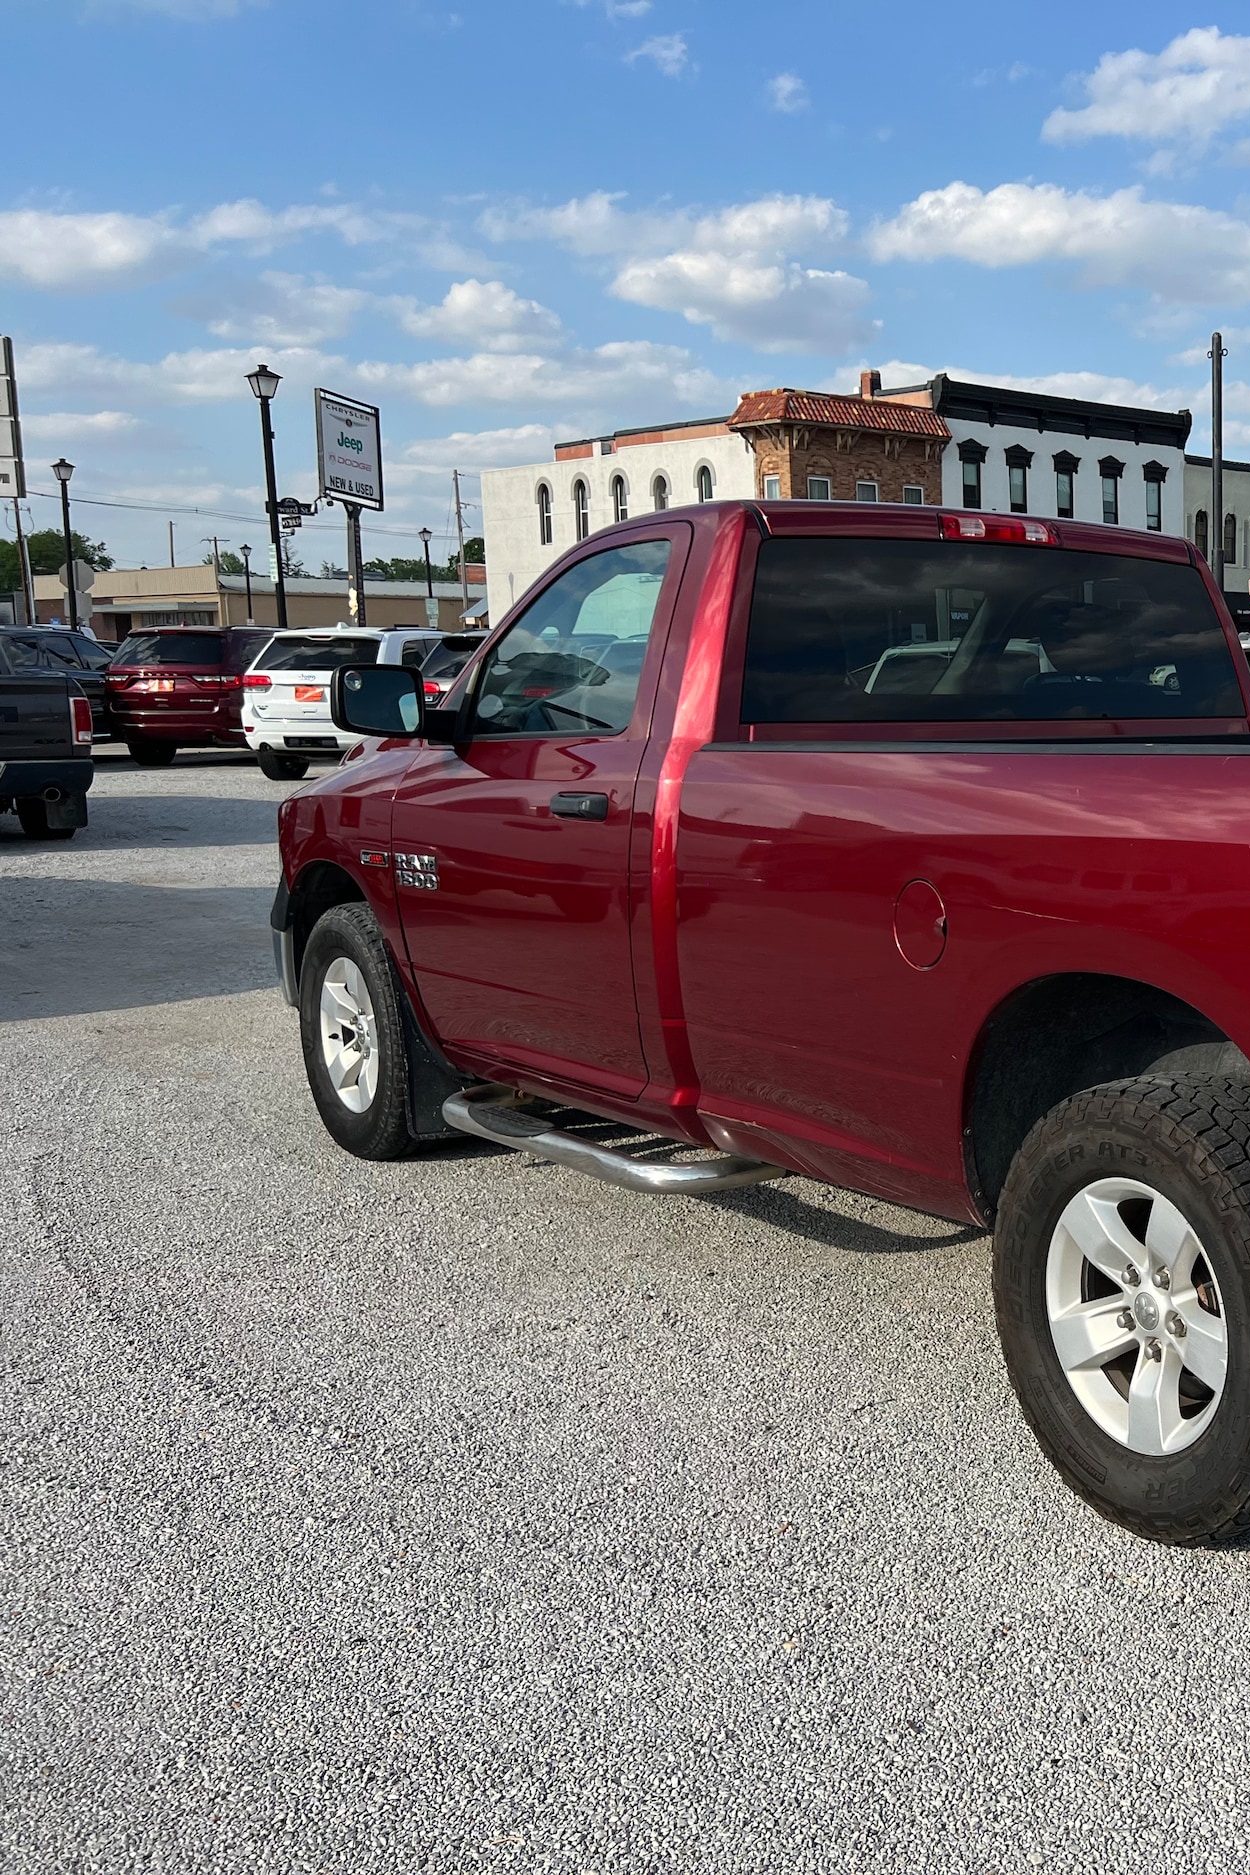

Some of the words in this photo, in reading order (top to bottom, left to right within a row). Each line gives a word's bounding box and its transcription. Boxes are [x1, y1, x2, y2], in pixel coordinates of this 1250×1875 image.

[325, 403, 371, 422] CHRYSLER
[337, 431, 363, 455] Jeep
[337, 456, 372, 472] DODGE
[329, 475, 346, 490] NEW
[348, 479, 354, 492] &
[355, 482, 374, 497] USED
[394, 852, 436, 873] RAM
[396, 870, 438, 891] 1500
